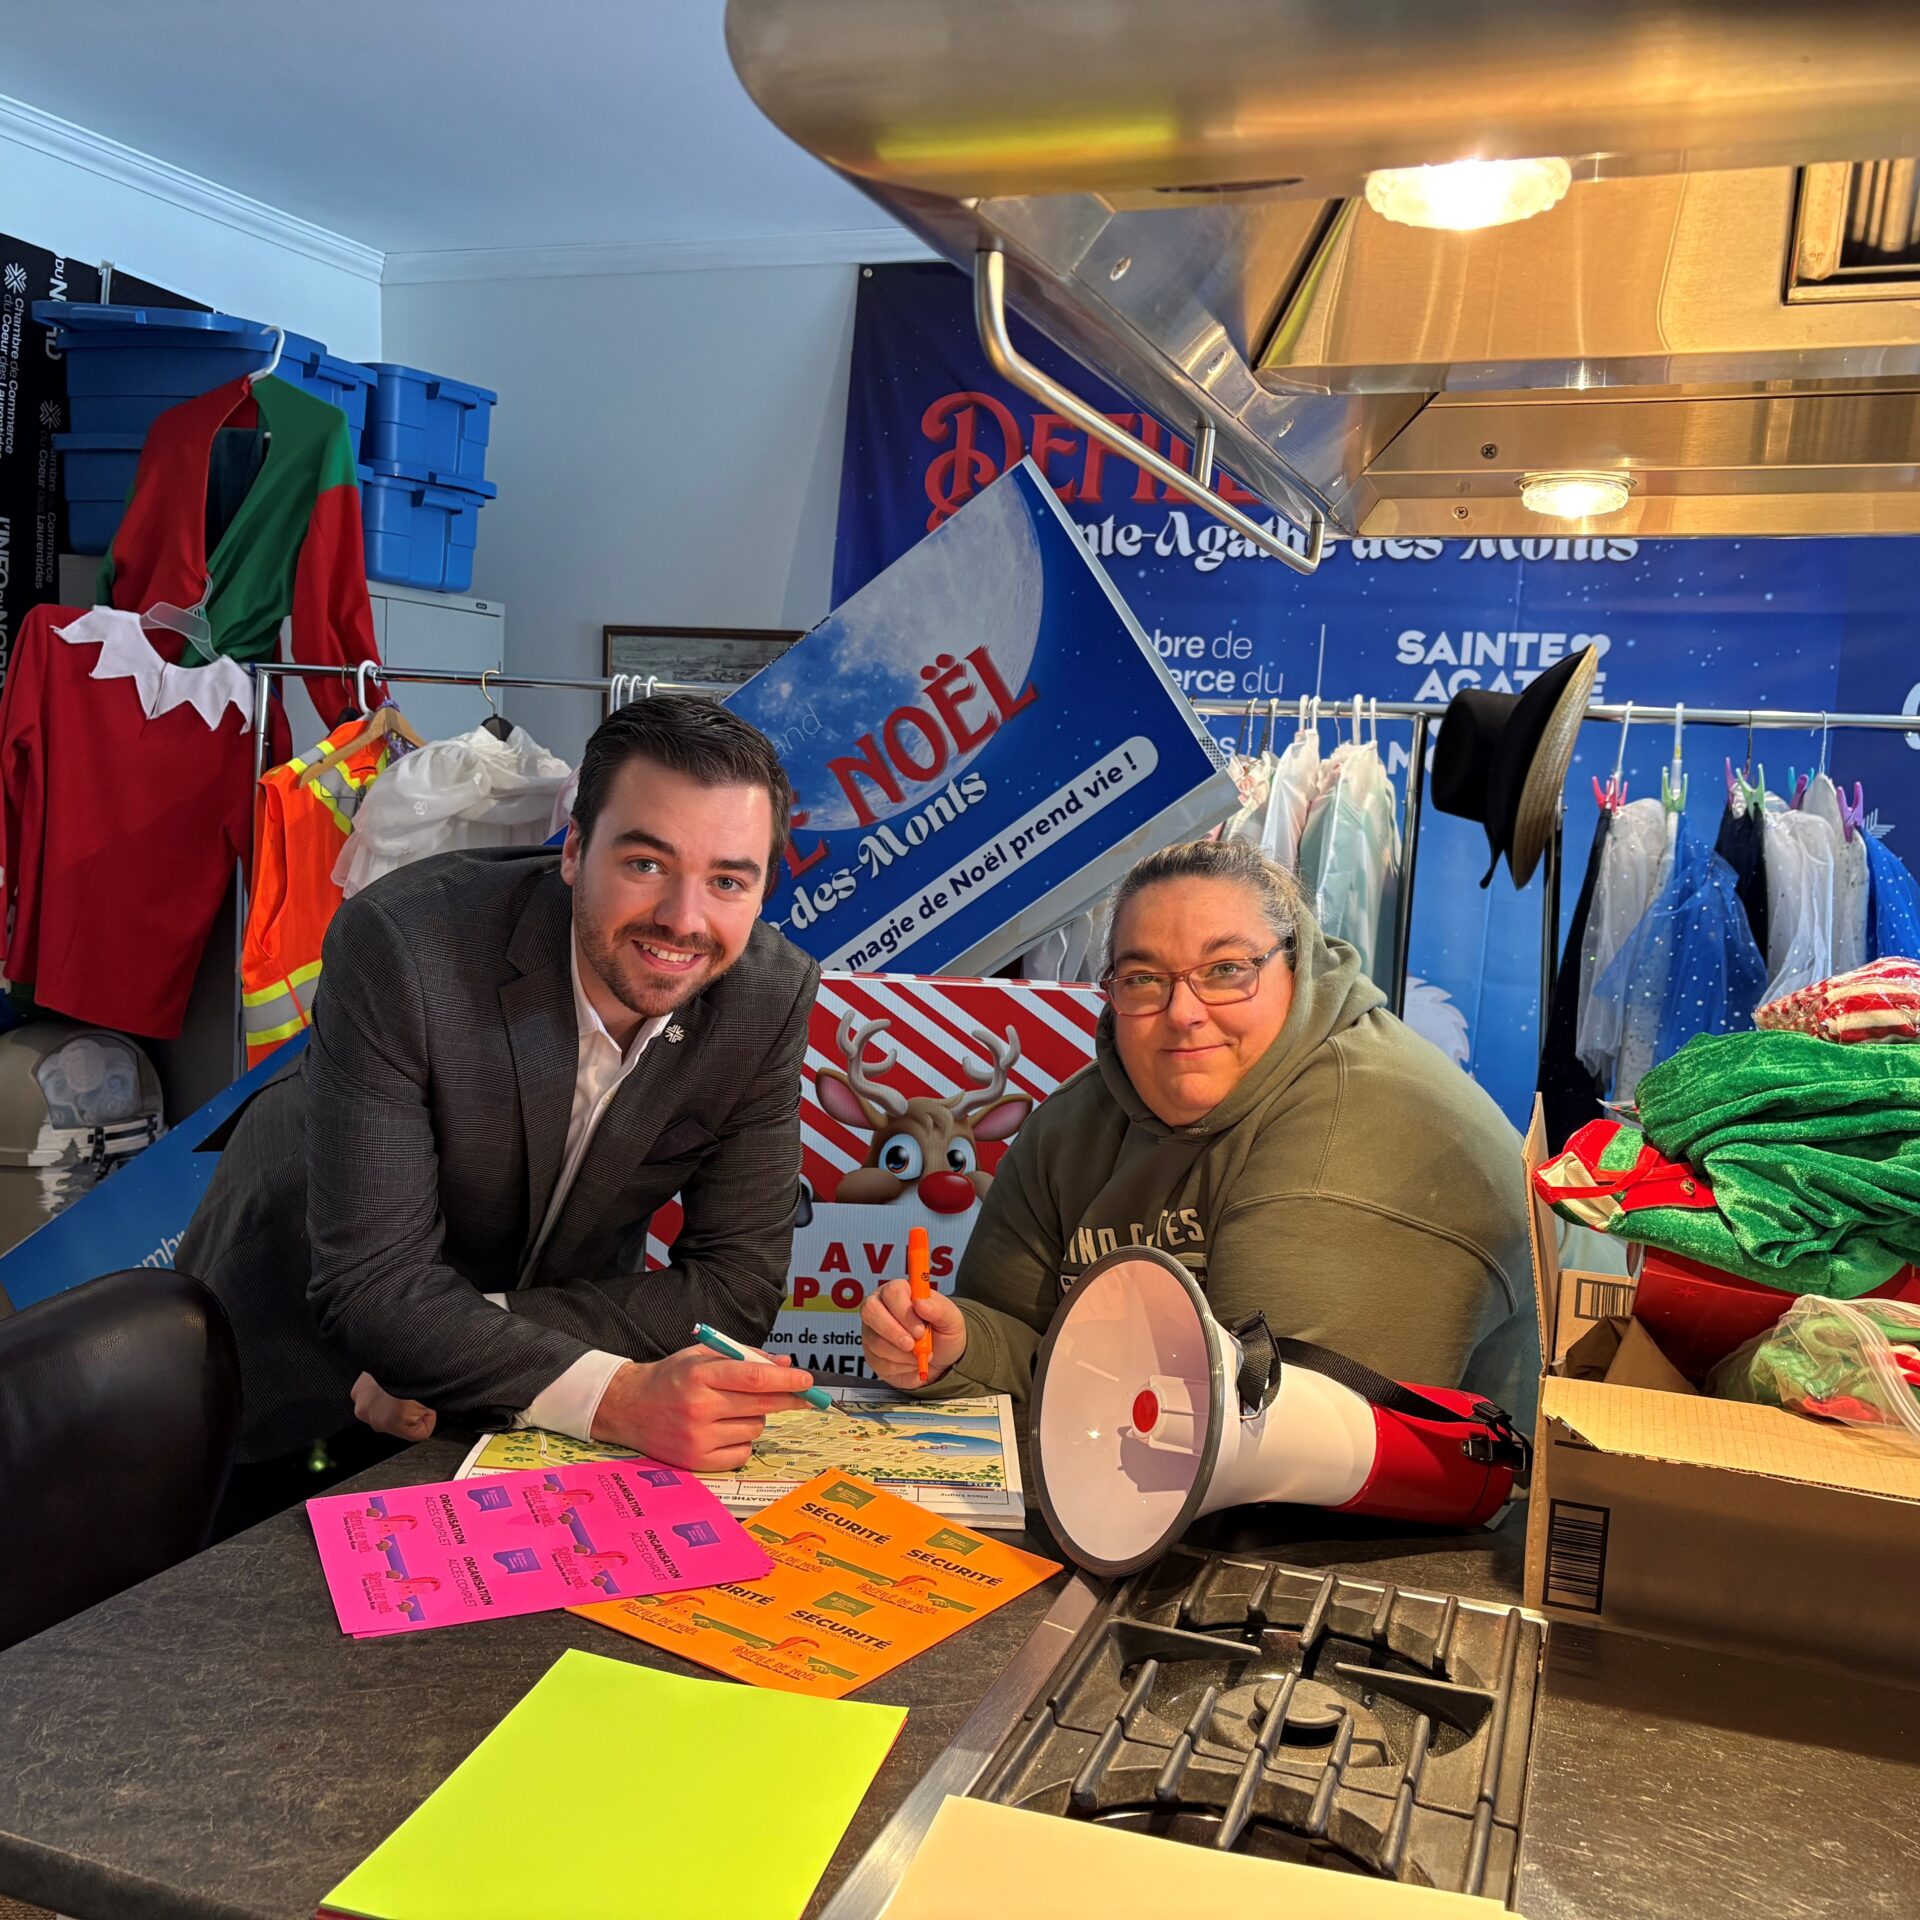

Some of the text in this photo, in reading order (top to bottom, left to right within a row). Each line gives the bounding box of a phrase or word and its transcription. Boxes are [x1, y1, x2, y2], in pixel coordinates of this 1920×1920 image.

[3, 293, 13, 312] du
[0, 313, 12, 355] Coeur
[5, 297, 25, 454] Chambre de Commerce
[35, 515, 46, 589] Laurentides
[1151, 629, 1253, 660] bre de
[1396, 630, 1567, 667] SAINTE
[1169, 665, 1284, 695] erce du
[776, 703, 823, 762] and
[826, 645, 1038, 828] NOËL
[846, 917, 915, 972] magie
[918, 895, 950, 921] de
[948, 842, 1008, 897] Noël
[1008, 789, 1084, 861] prend
[1083, 769, 1124, 799] vie
[819, 1241, 954, 1277] AVS
[768, 1329, 793, 1343] ion
[798, 1327, 817, 1343] de
[610, 1472, 645, 1519] ORGANISATION
[438, 1493, 467, 1545] ORGANISATION
[800, 1502, 893, 1545] SÉCURITÉ
[644, 1529, 682, 1580] ORGANISATION
[905, 1548, 1004, 1587] SÉCURITÉ
[463, 1555, 494, 1607] ORGANISATION
[715, 1583, 777, 1606] URITÉ
[790, 1609, 894, 1650] SÉCURITÉ
